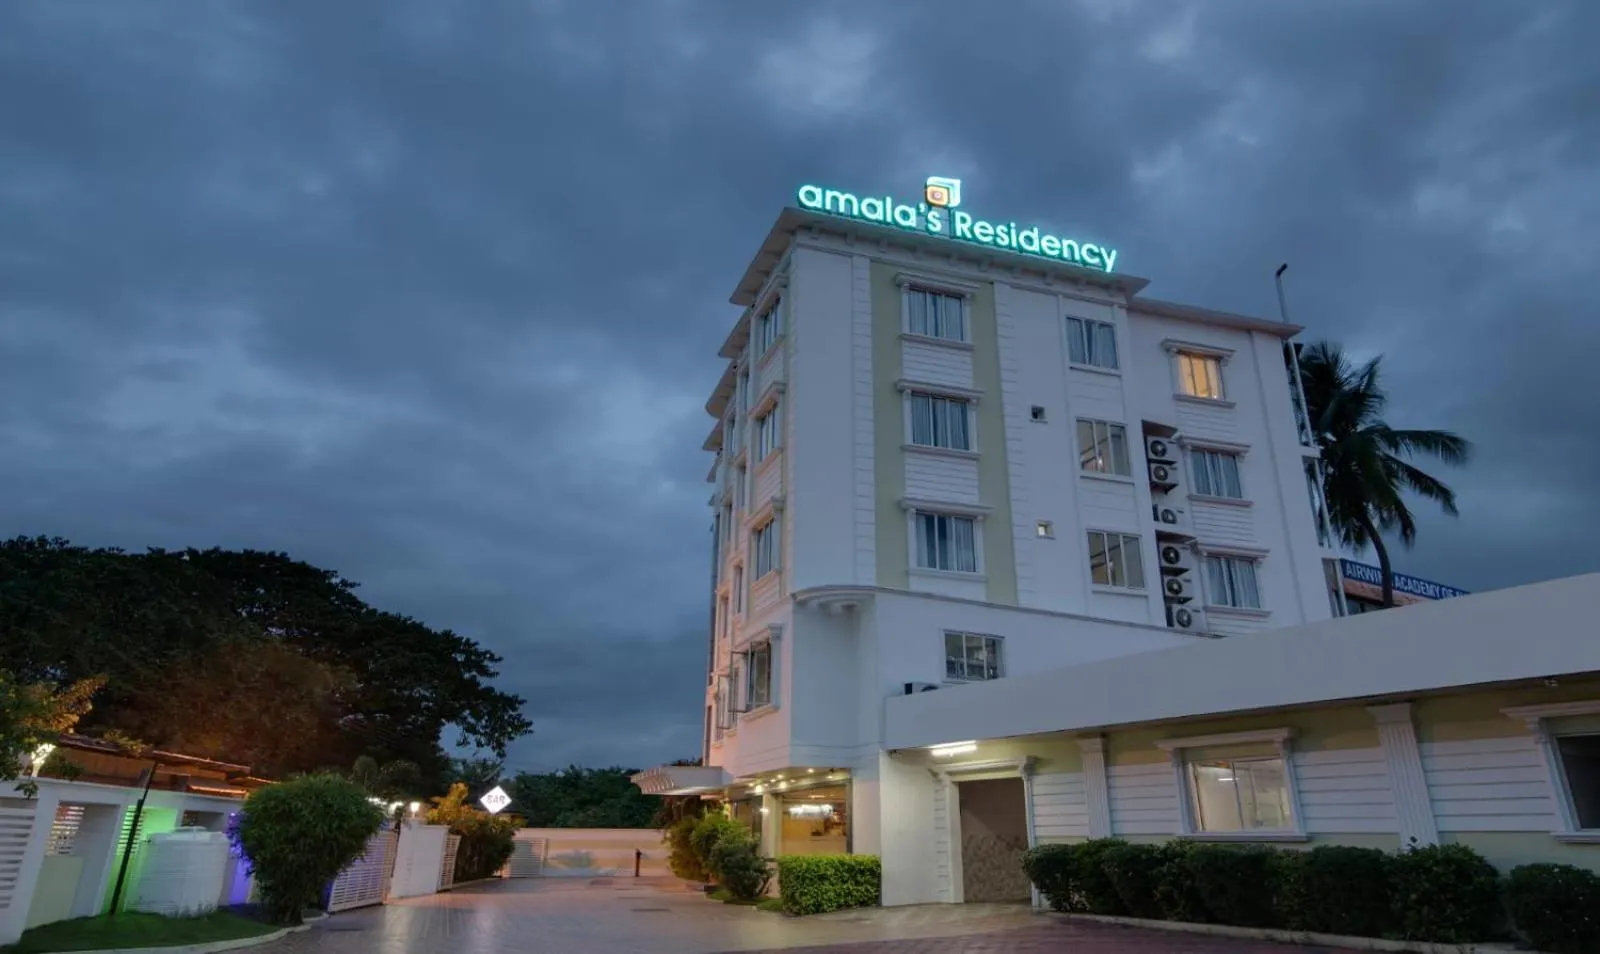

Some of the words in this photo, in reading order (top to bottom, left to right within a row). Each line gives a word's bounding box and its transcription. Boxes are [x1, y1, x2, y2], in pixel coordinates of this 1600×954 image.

[798, 184, 942, 232] amala's
[953, 210, 1118, 272] Residency
[1394, 575, 1441, 599] ACADEMY
